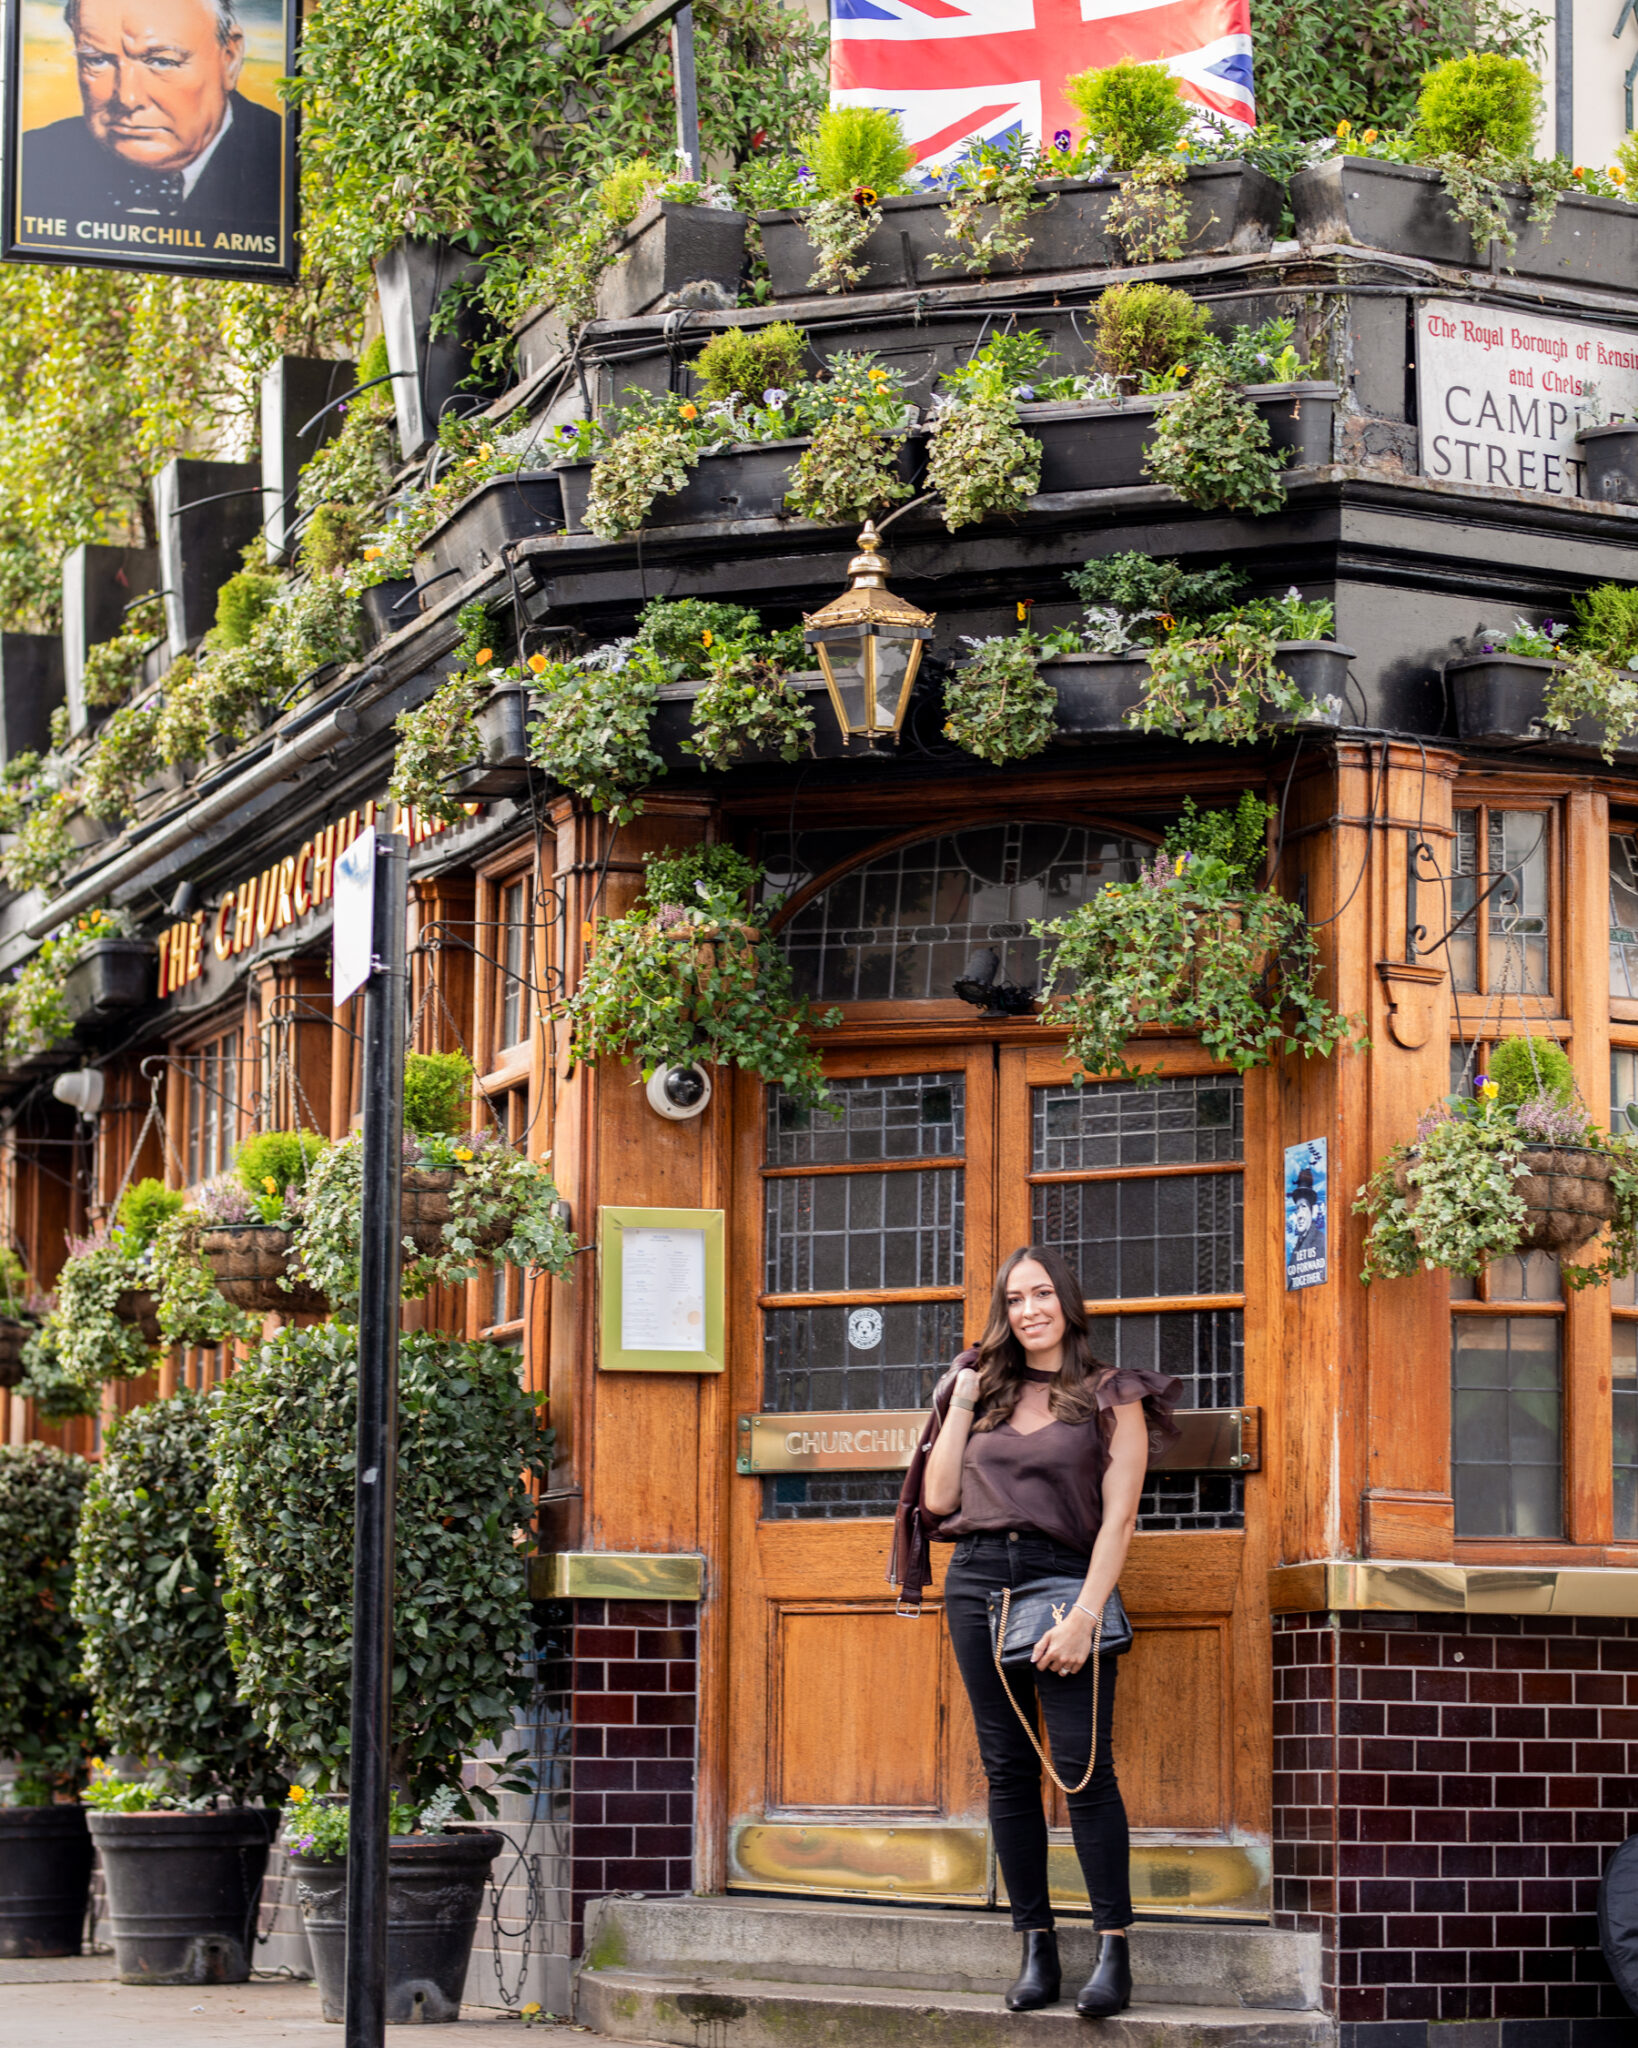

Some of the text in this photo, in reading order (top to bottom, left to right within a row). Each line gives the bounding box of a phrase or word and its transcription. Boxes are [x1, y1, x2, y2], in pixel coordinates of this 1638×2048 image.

[24, 216, 276, 254] THE CHURCHILL ARMS
[1427, 315, 1457, 339] The
[1460, 320, 1504, 351] Royal
[1511, 328, 1568, 363] Borough
[1576, 341, 1591, 362] of
[1508, 367, 1597, 396] and Chels
[1445, 385, 1638, 441] CAMP
[1433, 434, 1587, 499] STREET
[157, 909, 207, 998] THE
[1288, 1257, 1326, 1276] GO FORWARD
[785, 1427, 919, 1455] CHURCHILL
